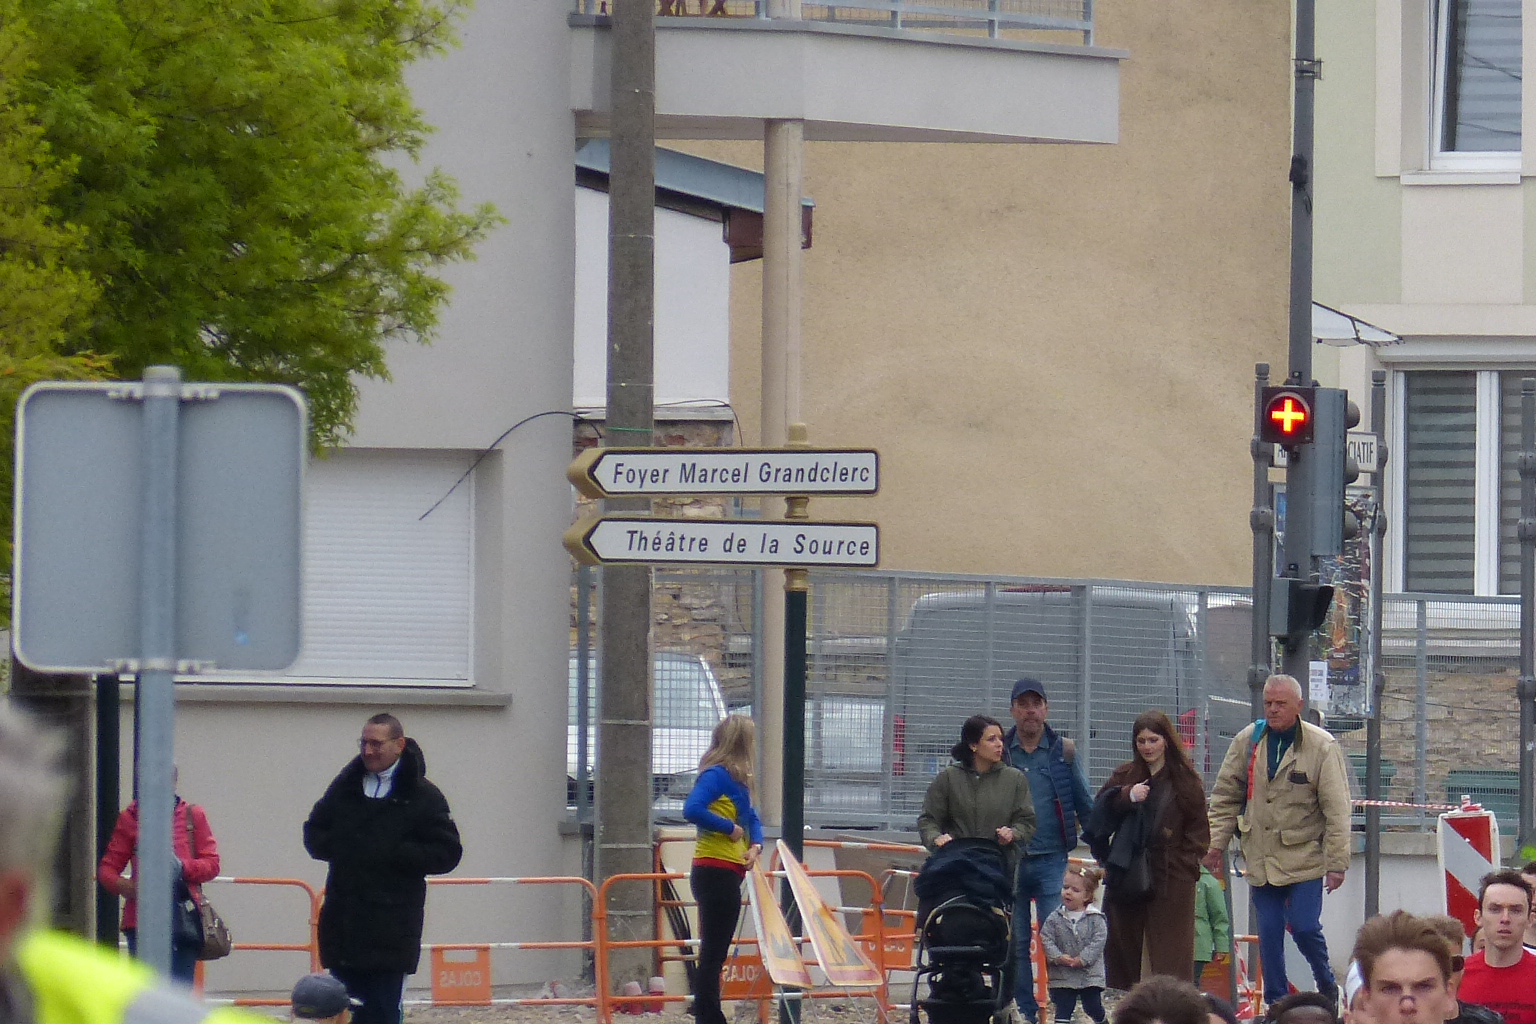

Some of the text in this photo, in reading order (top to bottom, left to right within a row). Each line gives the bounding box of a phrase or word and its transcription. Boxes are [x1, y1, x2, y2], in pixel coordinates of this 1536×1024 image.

[613, 461, 870, 488] Foyer Marcel Grandclerc
[626, 529, 870, 556] Théâtre de la Source
